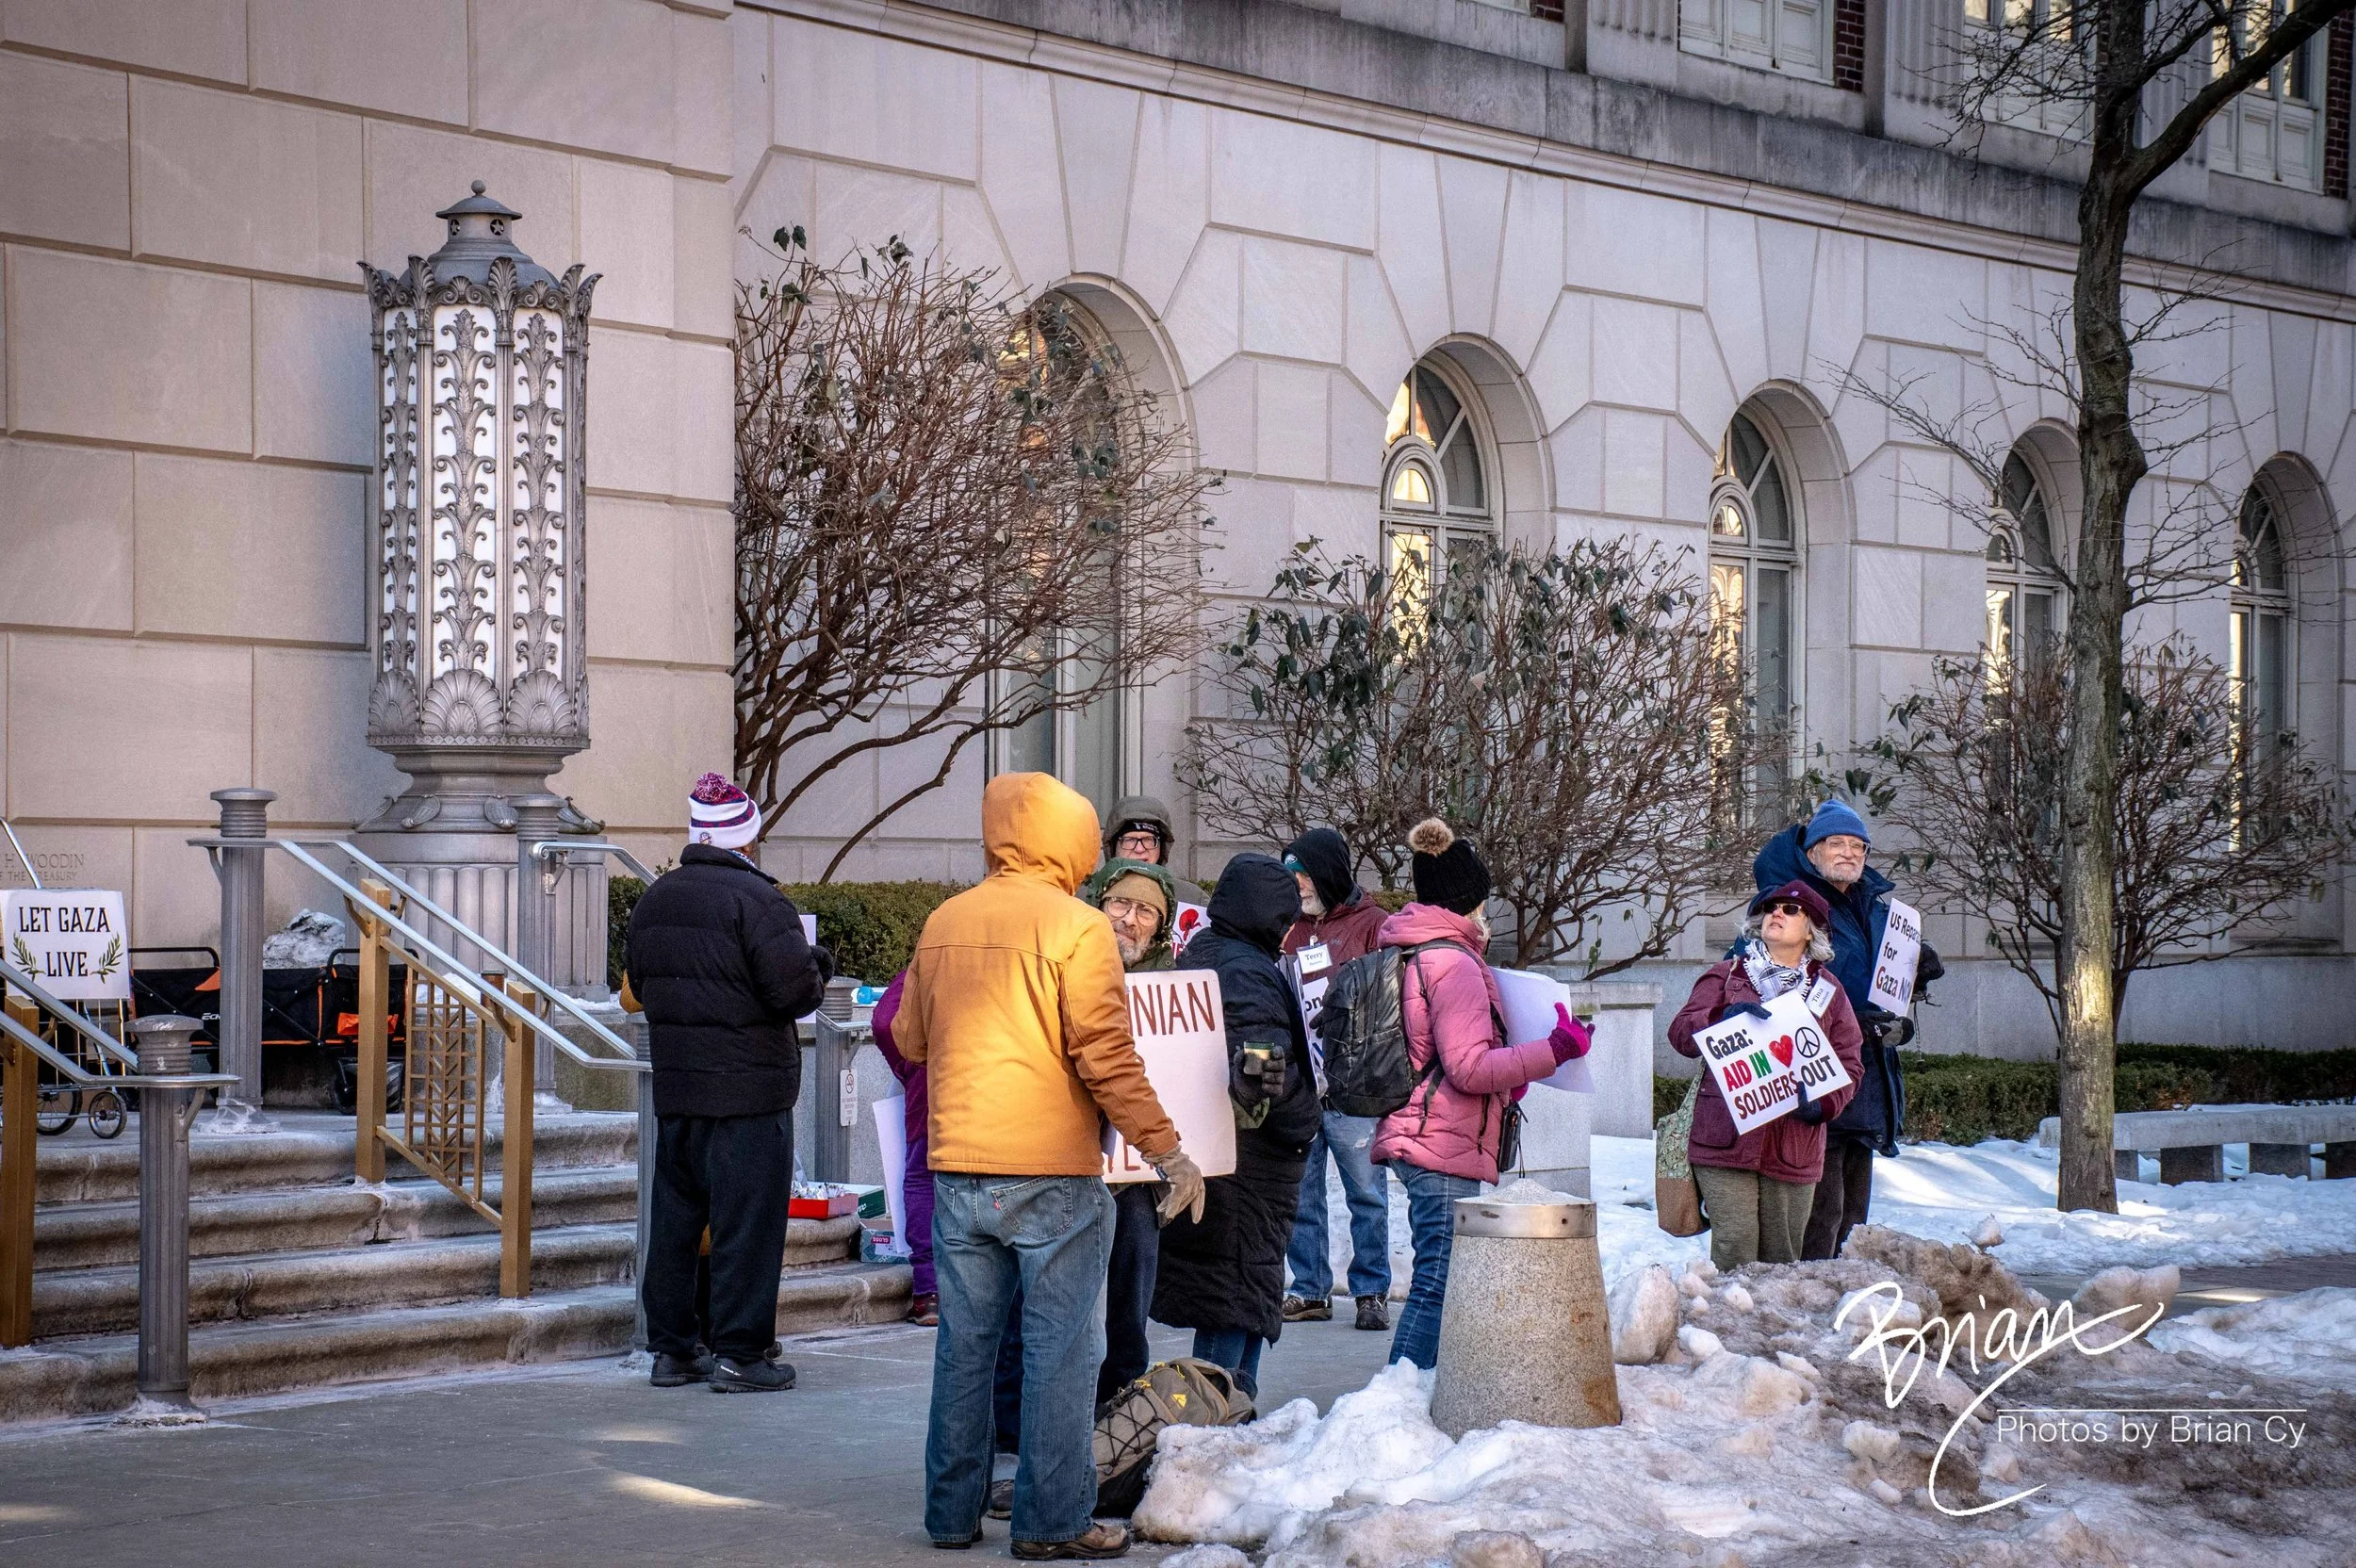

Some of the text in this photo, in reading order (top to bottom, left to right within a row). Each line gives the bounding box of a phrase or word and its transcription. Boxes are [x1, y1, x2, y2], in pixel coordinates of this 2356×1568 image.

[19, 906, 111, 933] LET GAZA
[1890, 911, 1902, 931] US
[45, 951, 89, 977] LIVE
[1304, 952, 1323, 961] Terry
[1883, 942, 1897, 961] for
[1875, 966, 1899, 998] Gaza
[1811, 988, 1824, 1003] Tina
[1706, 1029, 1753, 1060] Gaza:
[1723, 1050, 1773, 1092] AID IN
[1734, 1054, 1837, 1119] SOLDIERS OUT
